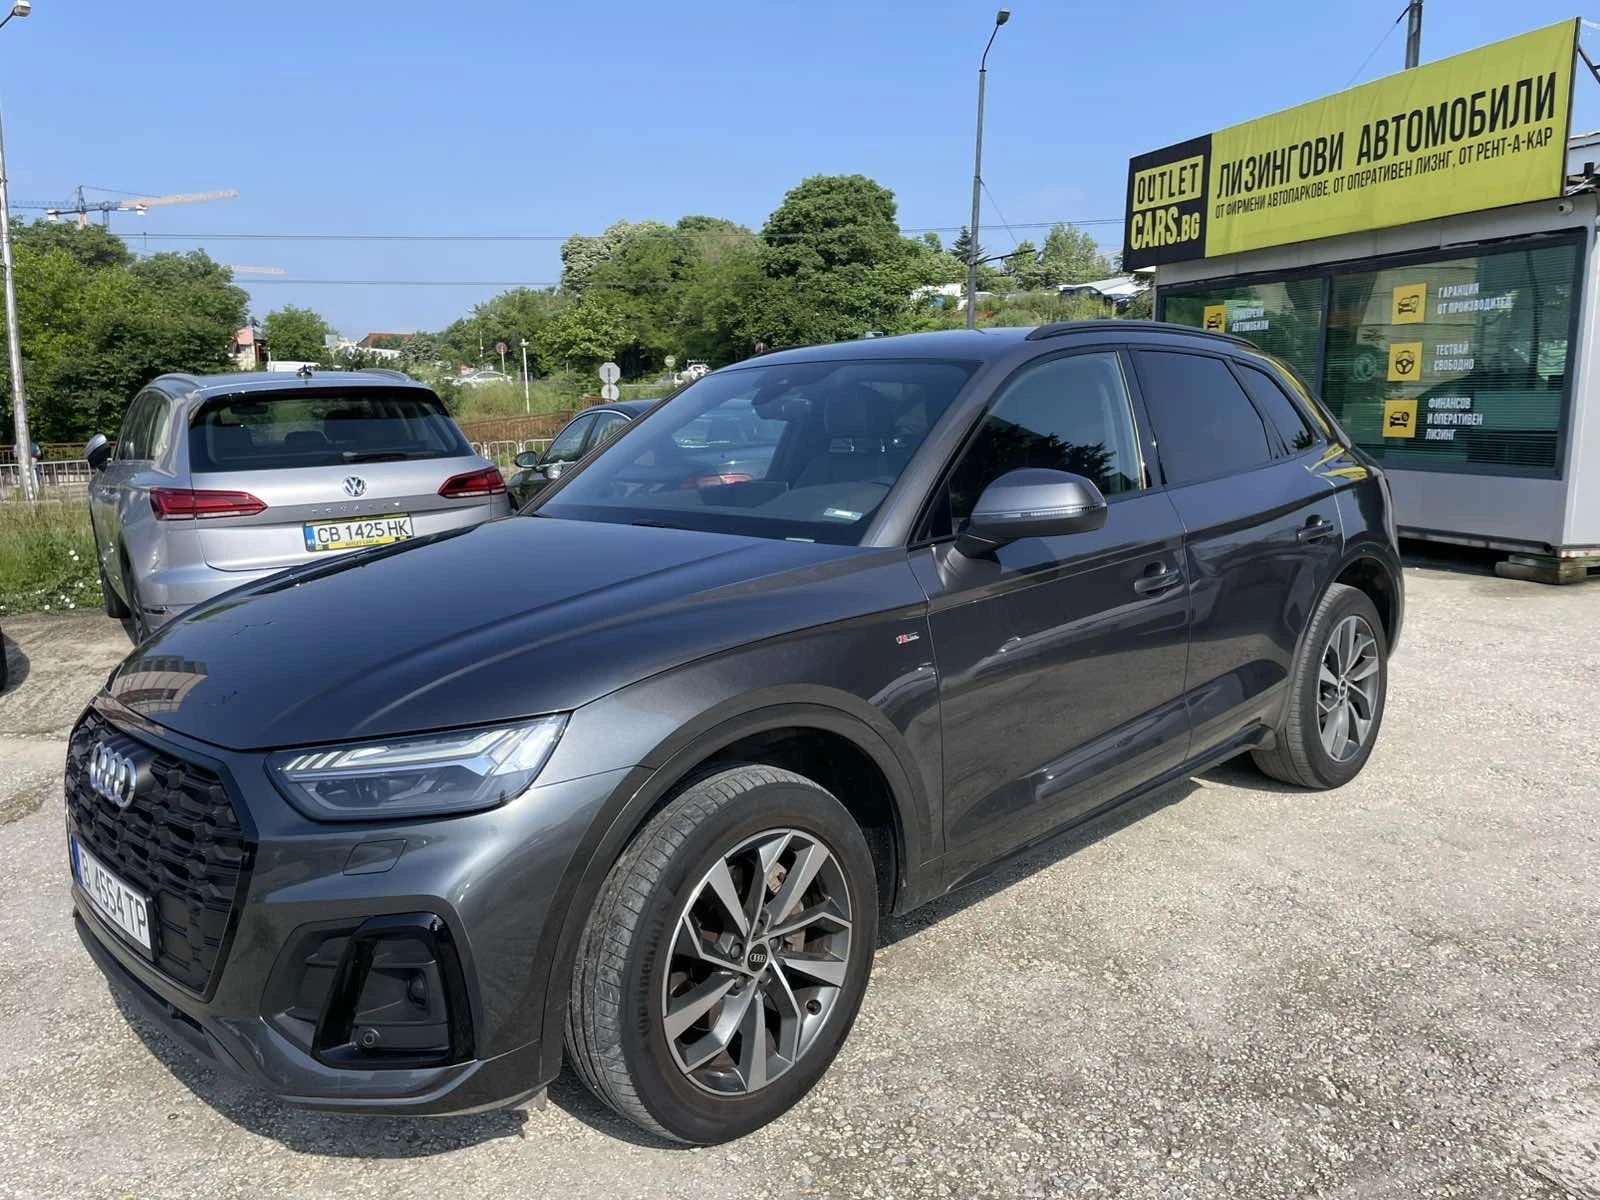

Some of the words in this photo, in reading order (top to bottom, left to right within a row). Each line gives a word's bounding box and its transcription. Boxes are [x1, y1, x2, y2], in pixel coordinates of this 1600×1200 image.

[1217, 131, 1345, 199] ЛИЗИНГОВИ
[1356, 71, 1556, 166] АВТОМОБИЛИ
[1215, 203, 1226, 219] ОТ
[1226, 197, 1266, 216] ФИРМЕНИ
[1267, 179, 1331, 208] АВТОПАРКОВЕ,
[1333, 175, 1346, 194] ОТ
[1347, 159, 1412, 191] ОПЕРАТИВЕН
[1458, 145, 1475, 165] ОТ
[1476, 127, 1553, 161] РЕНТ-А-КАР
[1137, 162, 1199, 205] OUTLET
[1130, 206, 1201, 250] CARS.BG
[1438, 282, 1479, 298] ГАРАНЦИЯ
[1437, 303, 1447, 314] ОТ
[1436, 341, 1469, 355] ТЕСТВАЙ
[1434, 358, 1475, 372] СВОБОДНО
[1428, 397, 1471, 409] ФИНАНСОВ
[1427, 413, 1433, 425] И
[1434, 412, 1483, 425] ОПЕРАТИВЕН
[1425, 428, 1456, 440] ЛИЗИНГ
[317, 526, 341, 544] CB
[345, 522, 385, 541] 1425
[387, 519, 409, 537] HK
[95, 866, 127, 924] 4554
[125, 890, 146, 937] TP
